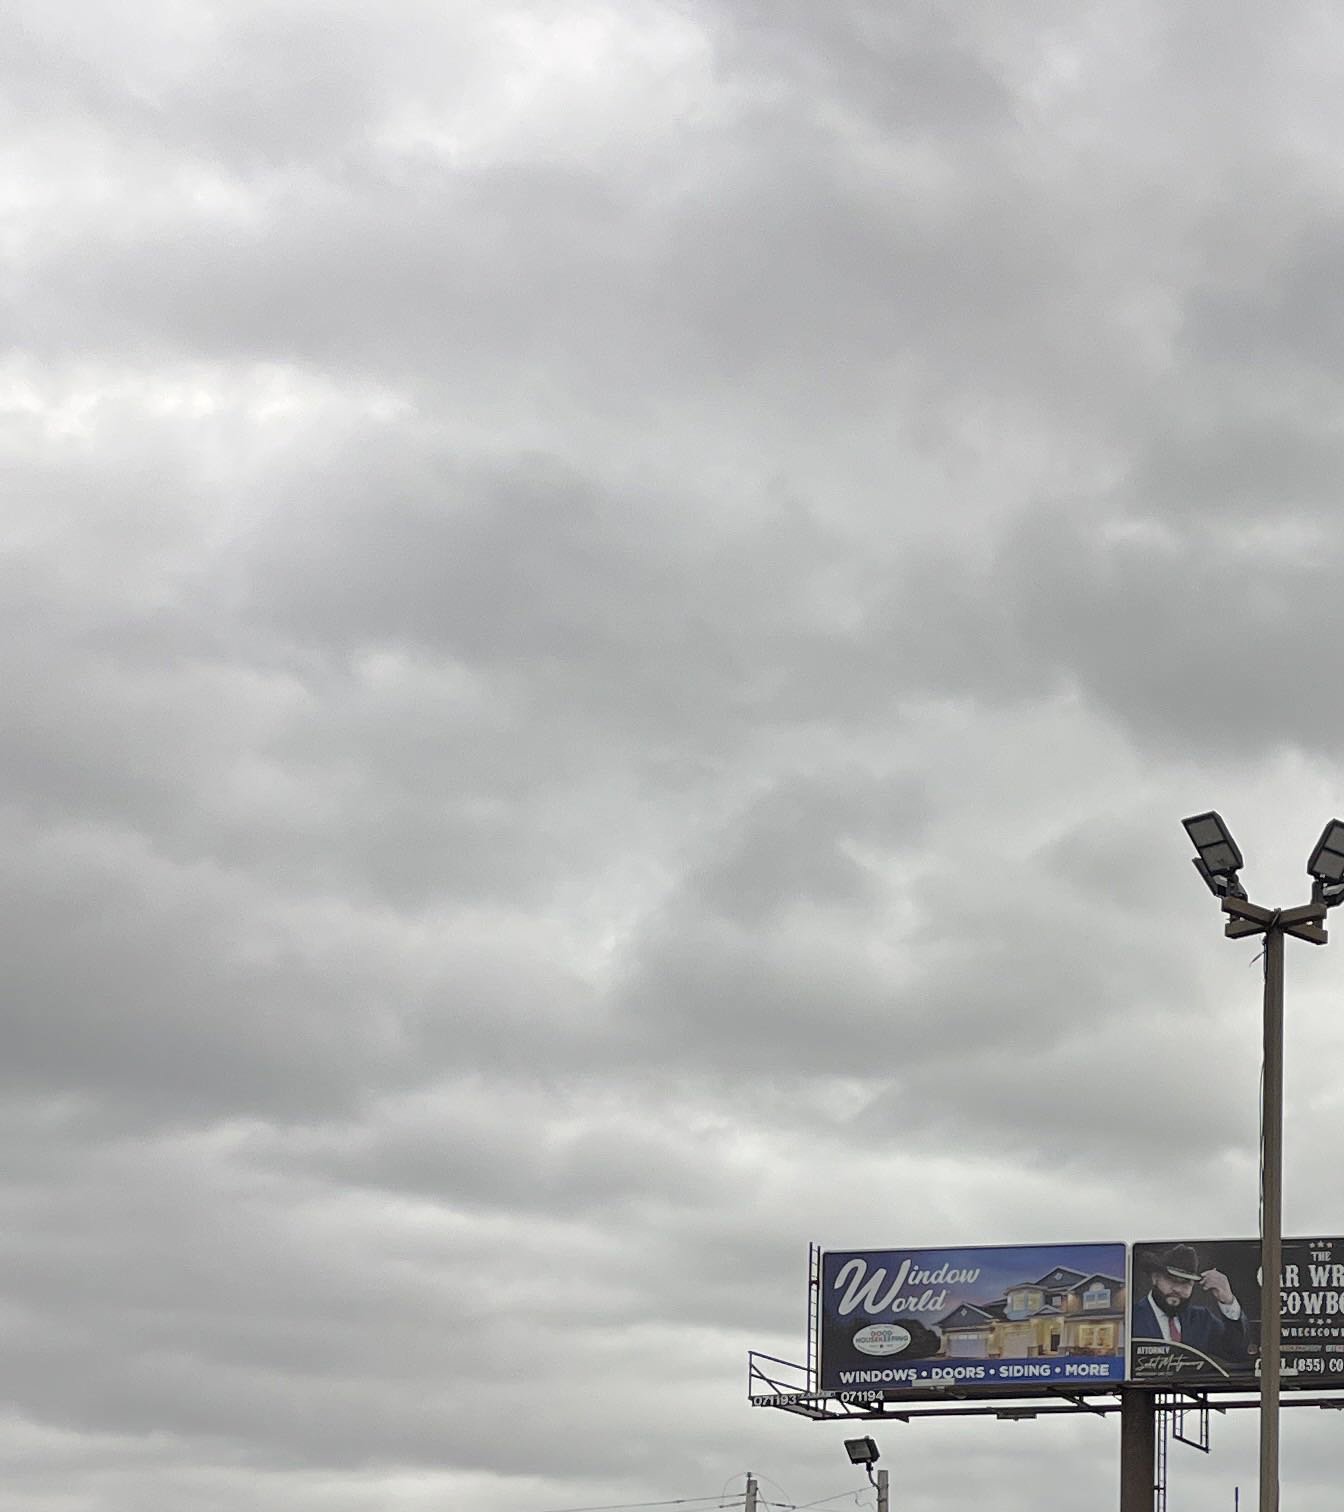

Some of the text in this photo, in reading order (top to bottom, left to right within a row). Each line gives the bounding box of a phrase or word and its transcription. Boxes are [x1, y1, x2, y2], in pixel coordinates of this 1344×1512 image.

[1310, 1251, 1332, 1262] THE
[834, 1258, 981, 1316] Window
[1136, 1346, 1170, 1355] ATTORNEY
[839, 1363, 1110, 1384] WINDOWS DOORS SIDING MORE
[753, 1394, 797, 1406] 071193
[840, 1390, 885, 1403] 071194
